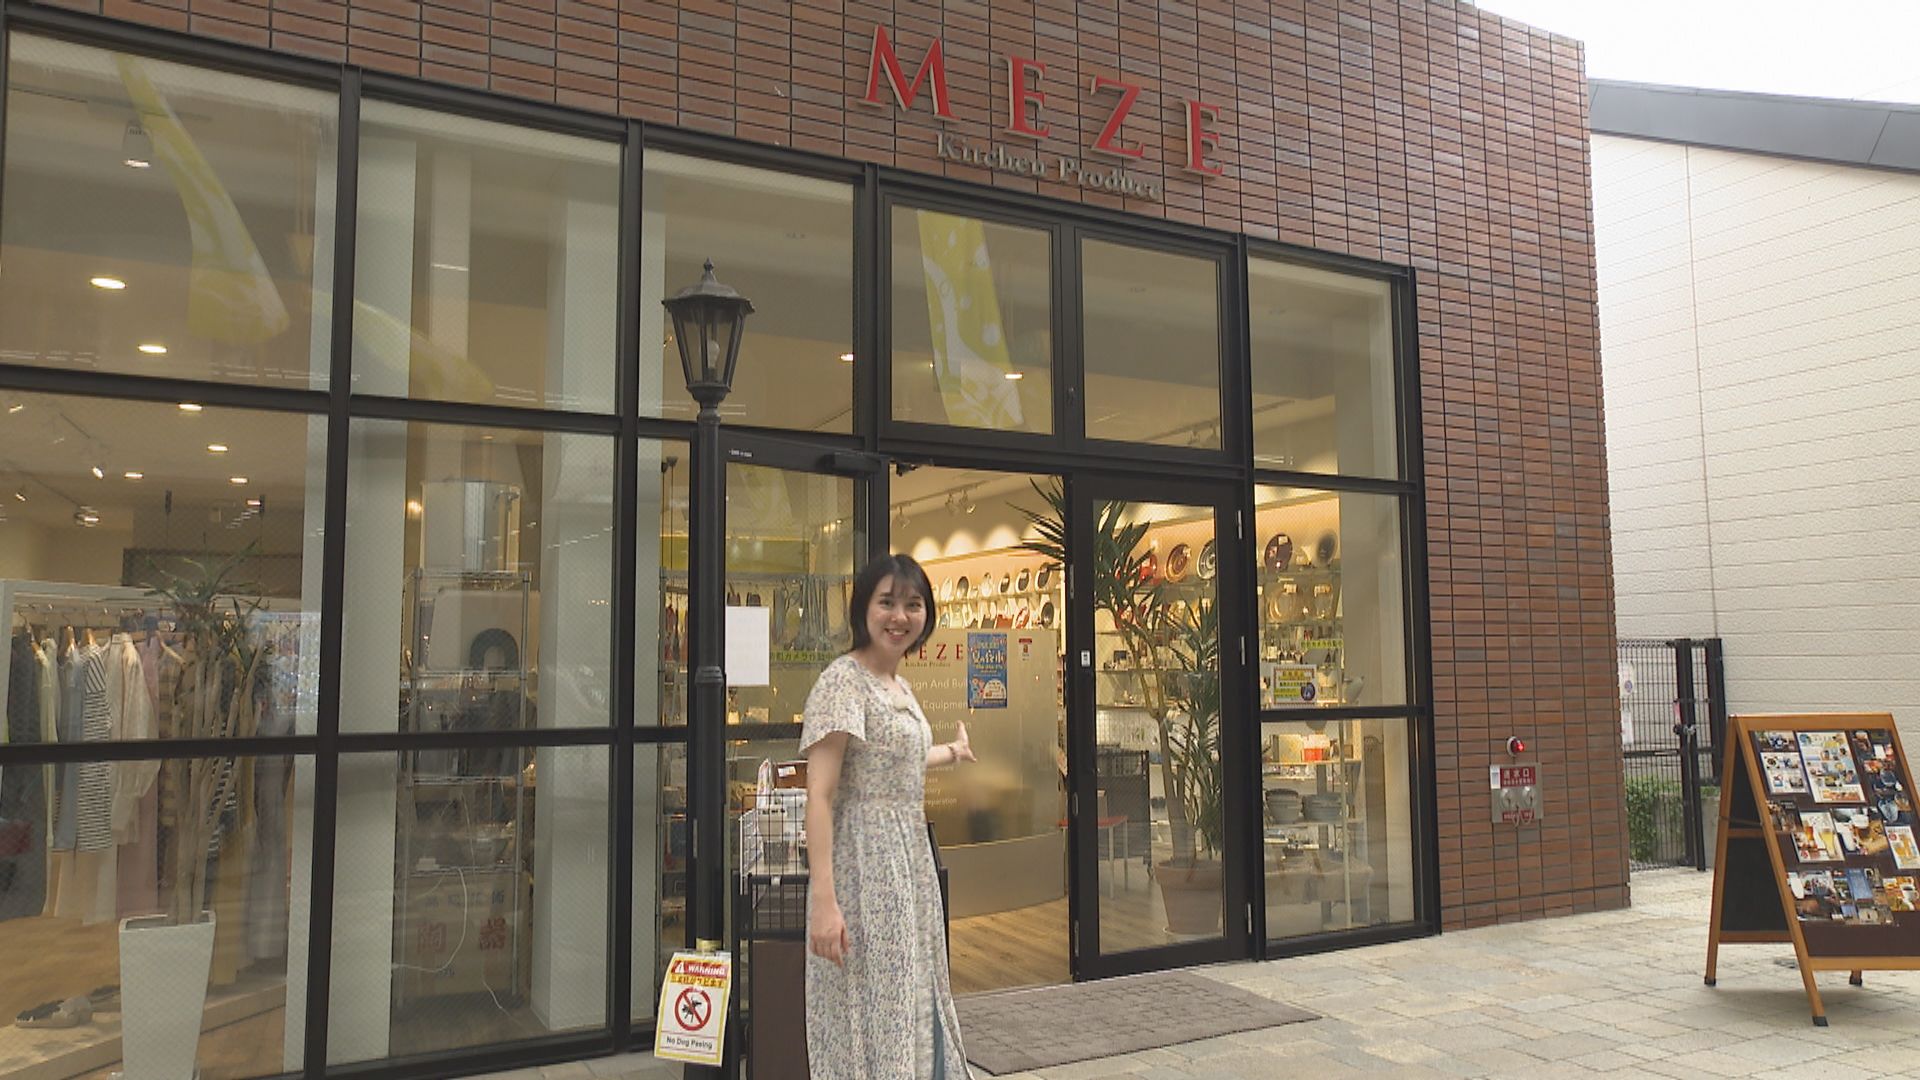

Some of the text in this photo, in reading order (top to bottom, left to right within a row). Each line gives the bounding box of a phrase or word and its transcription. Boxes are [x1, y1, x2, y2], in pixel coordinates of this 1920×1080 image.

[859, 24, 1223, 177] MEZE
[935, 131, 1047, 177] Kitchen
[930, 678, 950, 689] And
[922, 700, 968, 712] Equipmen
[688, 964, 726, 976] WARNING
[666, 1035, 676, 1044] No
[677, 1037, 690, 1047] Dog
